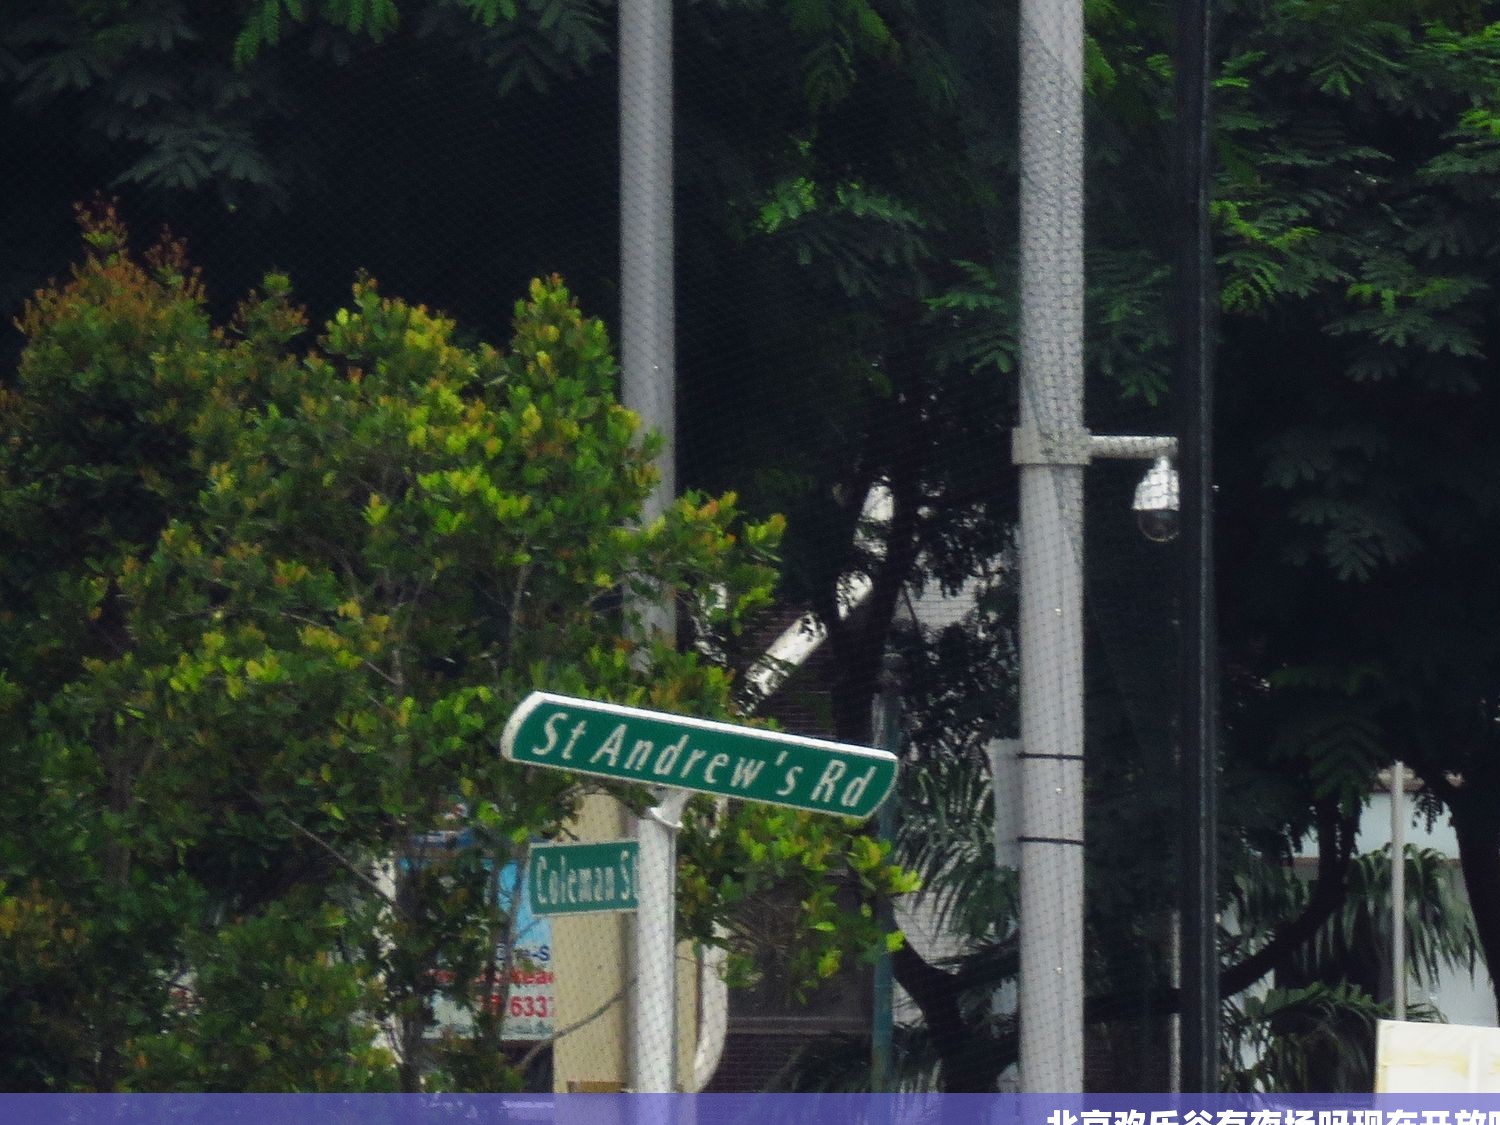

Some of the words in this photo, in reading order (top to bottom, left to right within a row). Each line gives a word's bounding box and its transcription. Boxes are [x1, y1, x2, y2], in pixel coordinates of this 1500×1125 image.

[532, 712, 587, 760] St
[590, 724, 804, 796] Andrew's
[810, 759, 877, 808] Rd
[537, 855, 615, 905] Coleman
